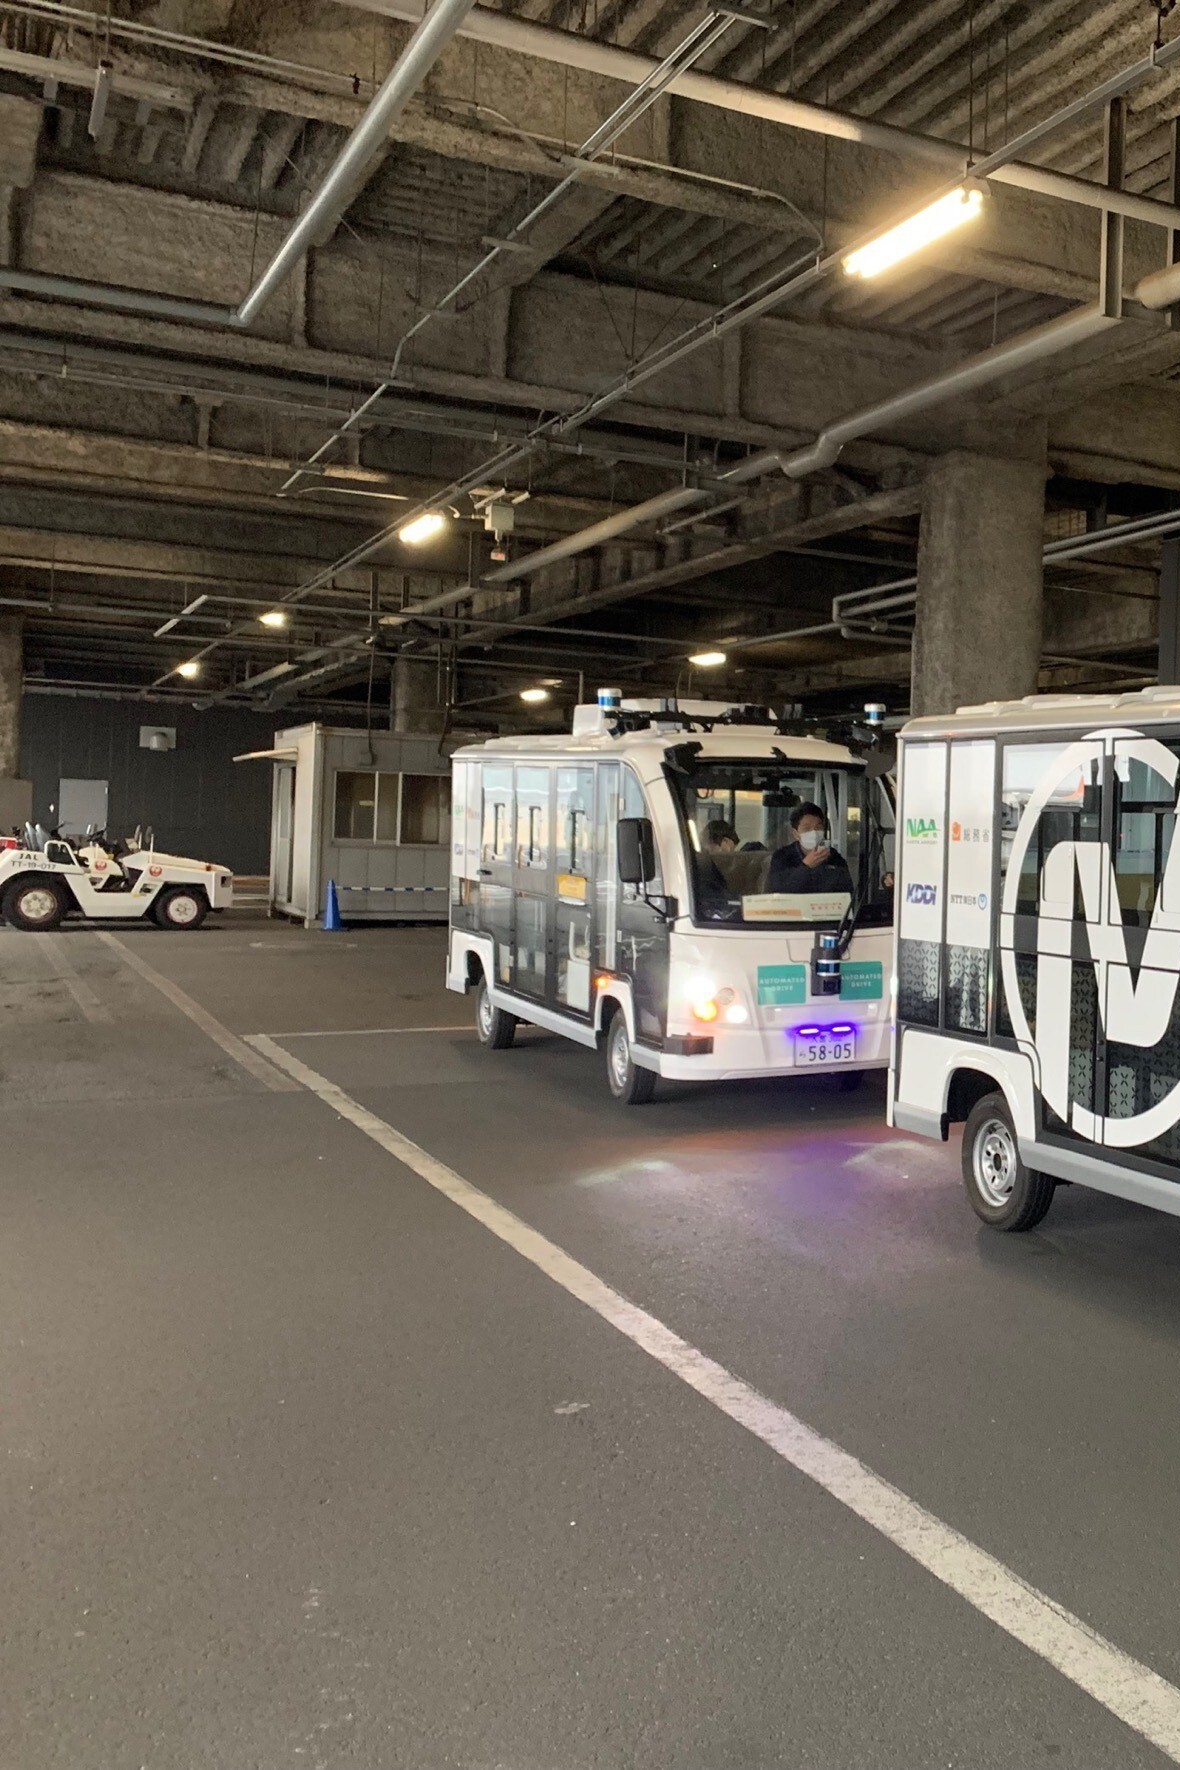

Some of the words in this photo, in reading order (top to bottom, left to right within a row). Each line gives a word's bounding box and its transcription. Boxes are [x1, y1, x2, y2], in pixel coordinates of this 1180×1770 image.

[906, 818, 939, 838] NAA
[19, 853, 39, 861] JAL
[906, 883, 937, 905] KDDI
[759, 976, 805, 985] AUTOMATED
[808, 1043, 852, 1062] 58-05
